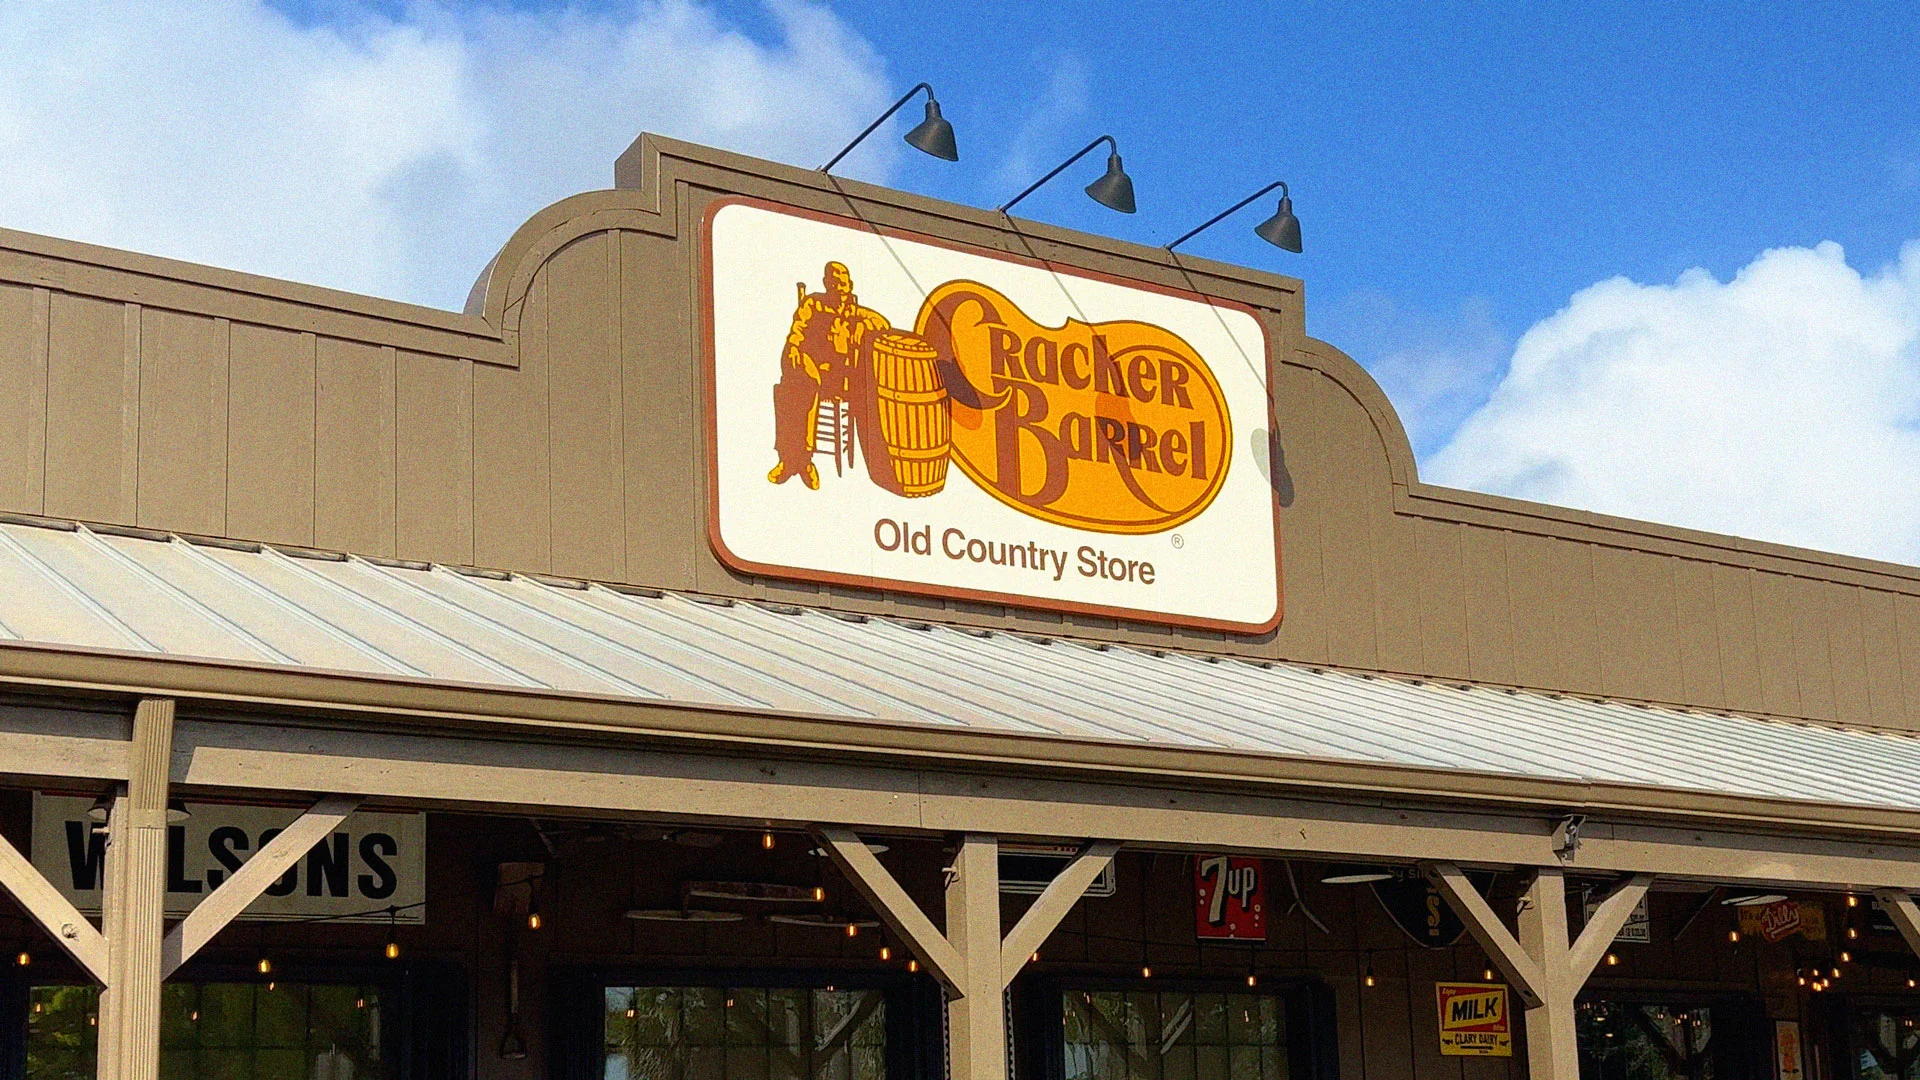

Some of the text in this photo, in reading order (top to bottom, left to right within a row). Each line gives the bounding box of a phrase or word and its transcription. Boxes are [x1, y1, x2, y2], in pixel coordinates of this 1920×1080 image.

[874, 518, 1156, 586] Old Country Store
[65, 820, 398, 900] WLSNS
[1452, 997, 1498, 1022] MILK
